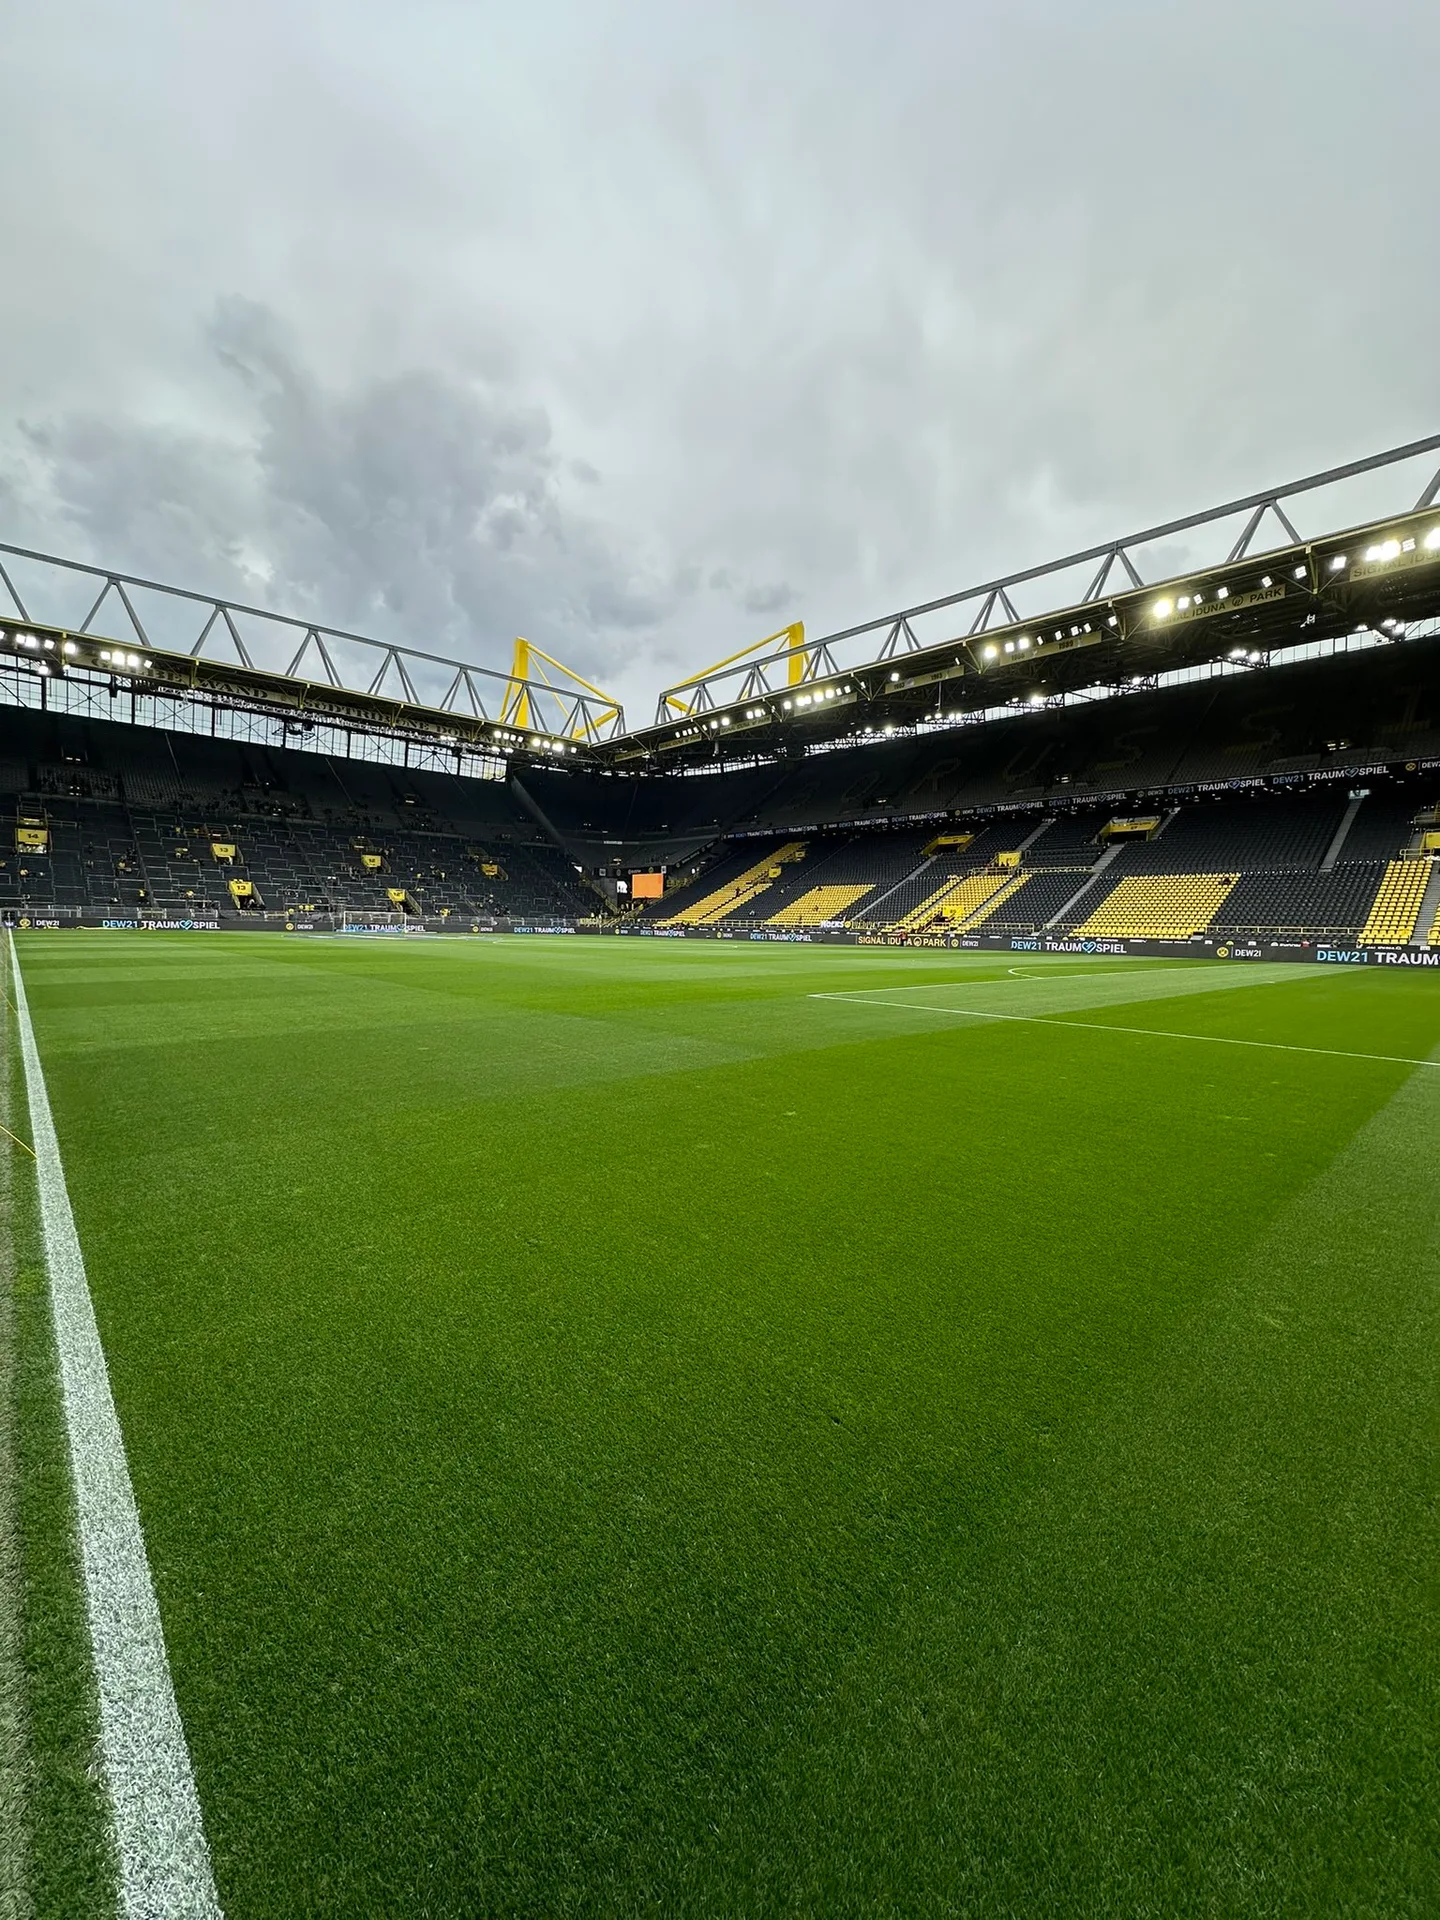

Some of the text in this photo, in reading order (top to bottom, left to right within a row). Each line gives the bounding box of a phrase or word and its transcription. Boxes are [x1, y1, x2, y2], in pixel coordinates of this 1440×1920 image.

[1409, 545, 1440, 564] IDU
[1192, 602, 1226, 617] IDUNA
[1249, 588, 1282, 603] PARK
[201, 676, 269, 699] WAND
[1273, 765, 1390, 785] DEW21 TRAUM SPIEL
[1168, 778, 1266, 795] DEW21 TRAUM SPIEL
[1072, 795, 1098, 804] TRAUM
[1107, 792, 1127, 801] SPIEL
[102, 920, 220, 930] DEW21 TRAUM SPIEL
[370, 924, 397, 932] TRAUM
[768, 933, 790, 941] TRAUM
[796, 934, 813, 942] SPIEL
[858, 936, 946, 947] SIGNAL IDUA PARK
[1011, 941, 1127, 954] DEW21 TRAUM SPIEL
[1317, 950, 1439, 965] DEW21 TRAUM
